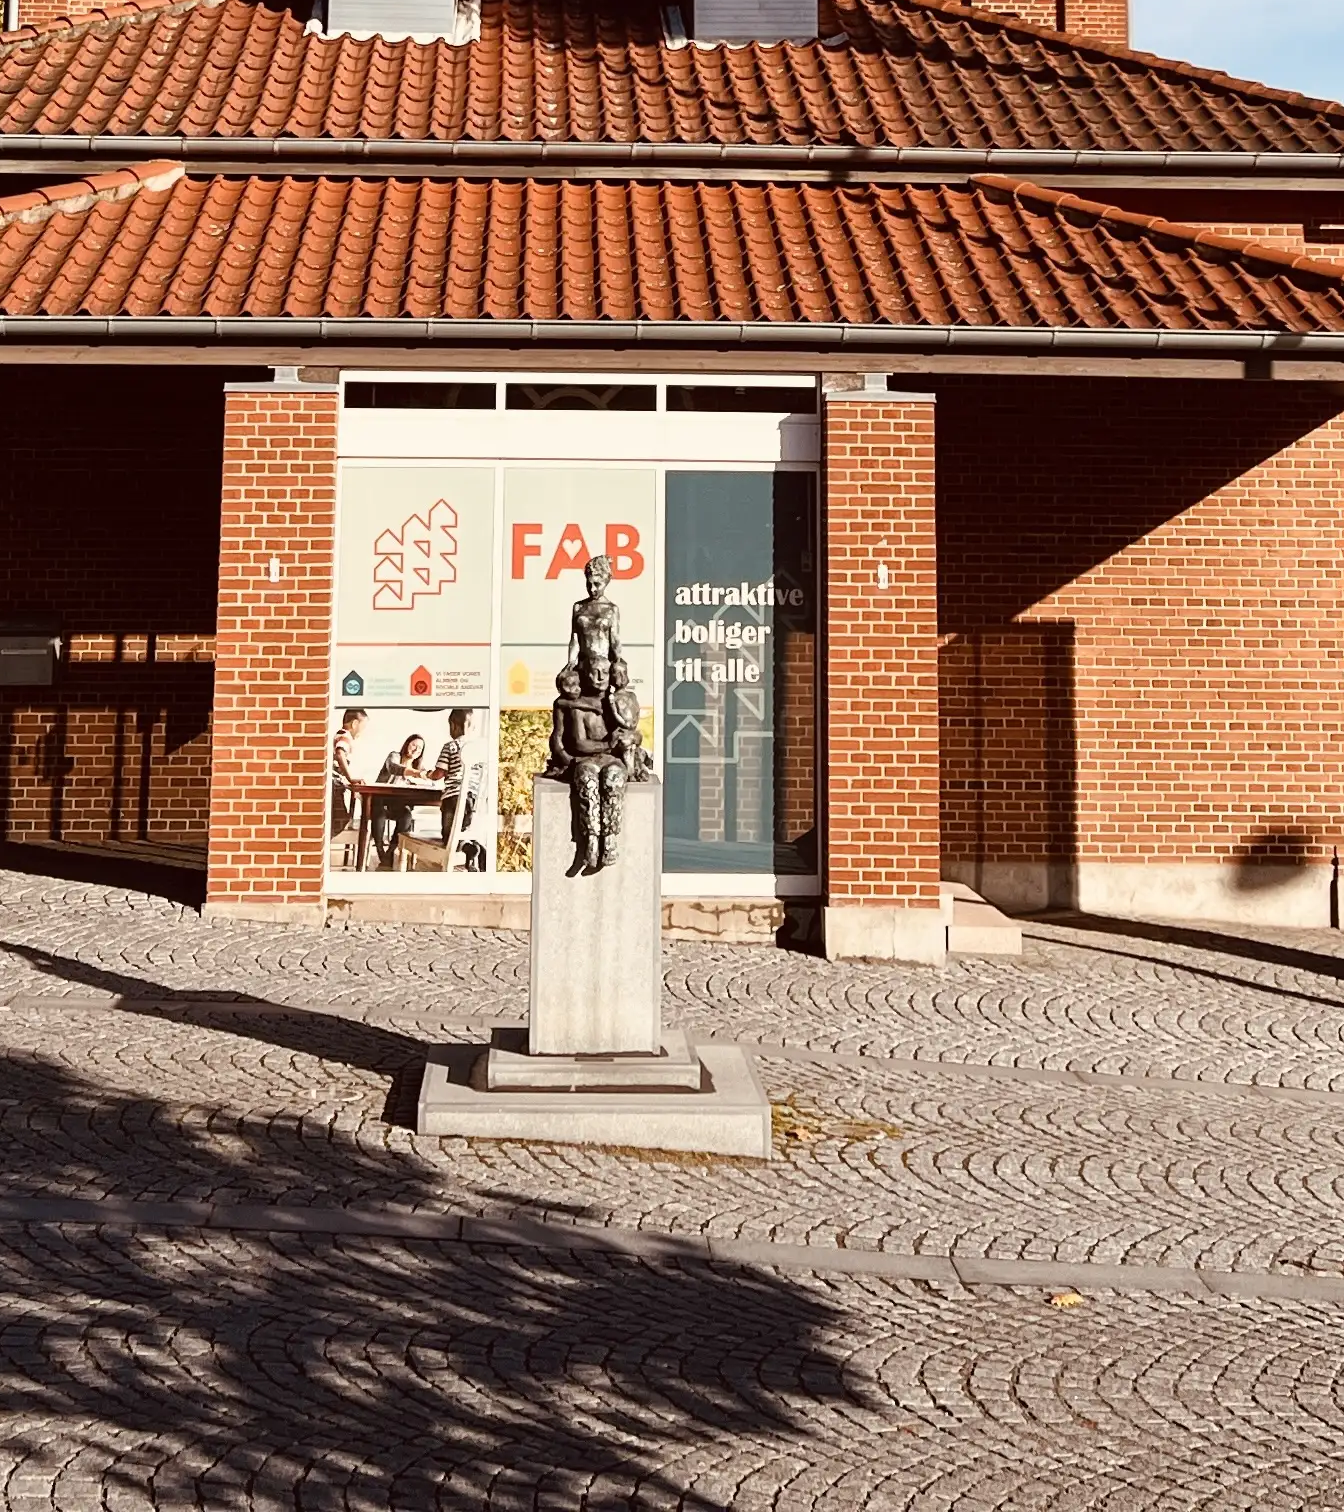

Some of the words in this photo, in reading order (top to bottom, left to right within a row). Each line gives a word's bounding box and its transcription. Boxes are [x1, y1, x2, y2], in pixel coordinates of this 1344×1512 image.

[512, 523, 645, 580] FAB
[675, 582, 804, 606] attraktive
[675, 619, 771, 649] boliger
[674, 658, 702, 682] til
[711, 658, 760, 683] alle
